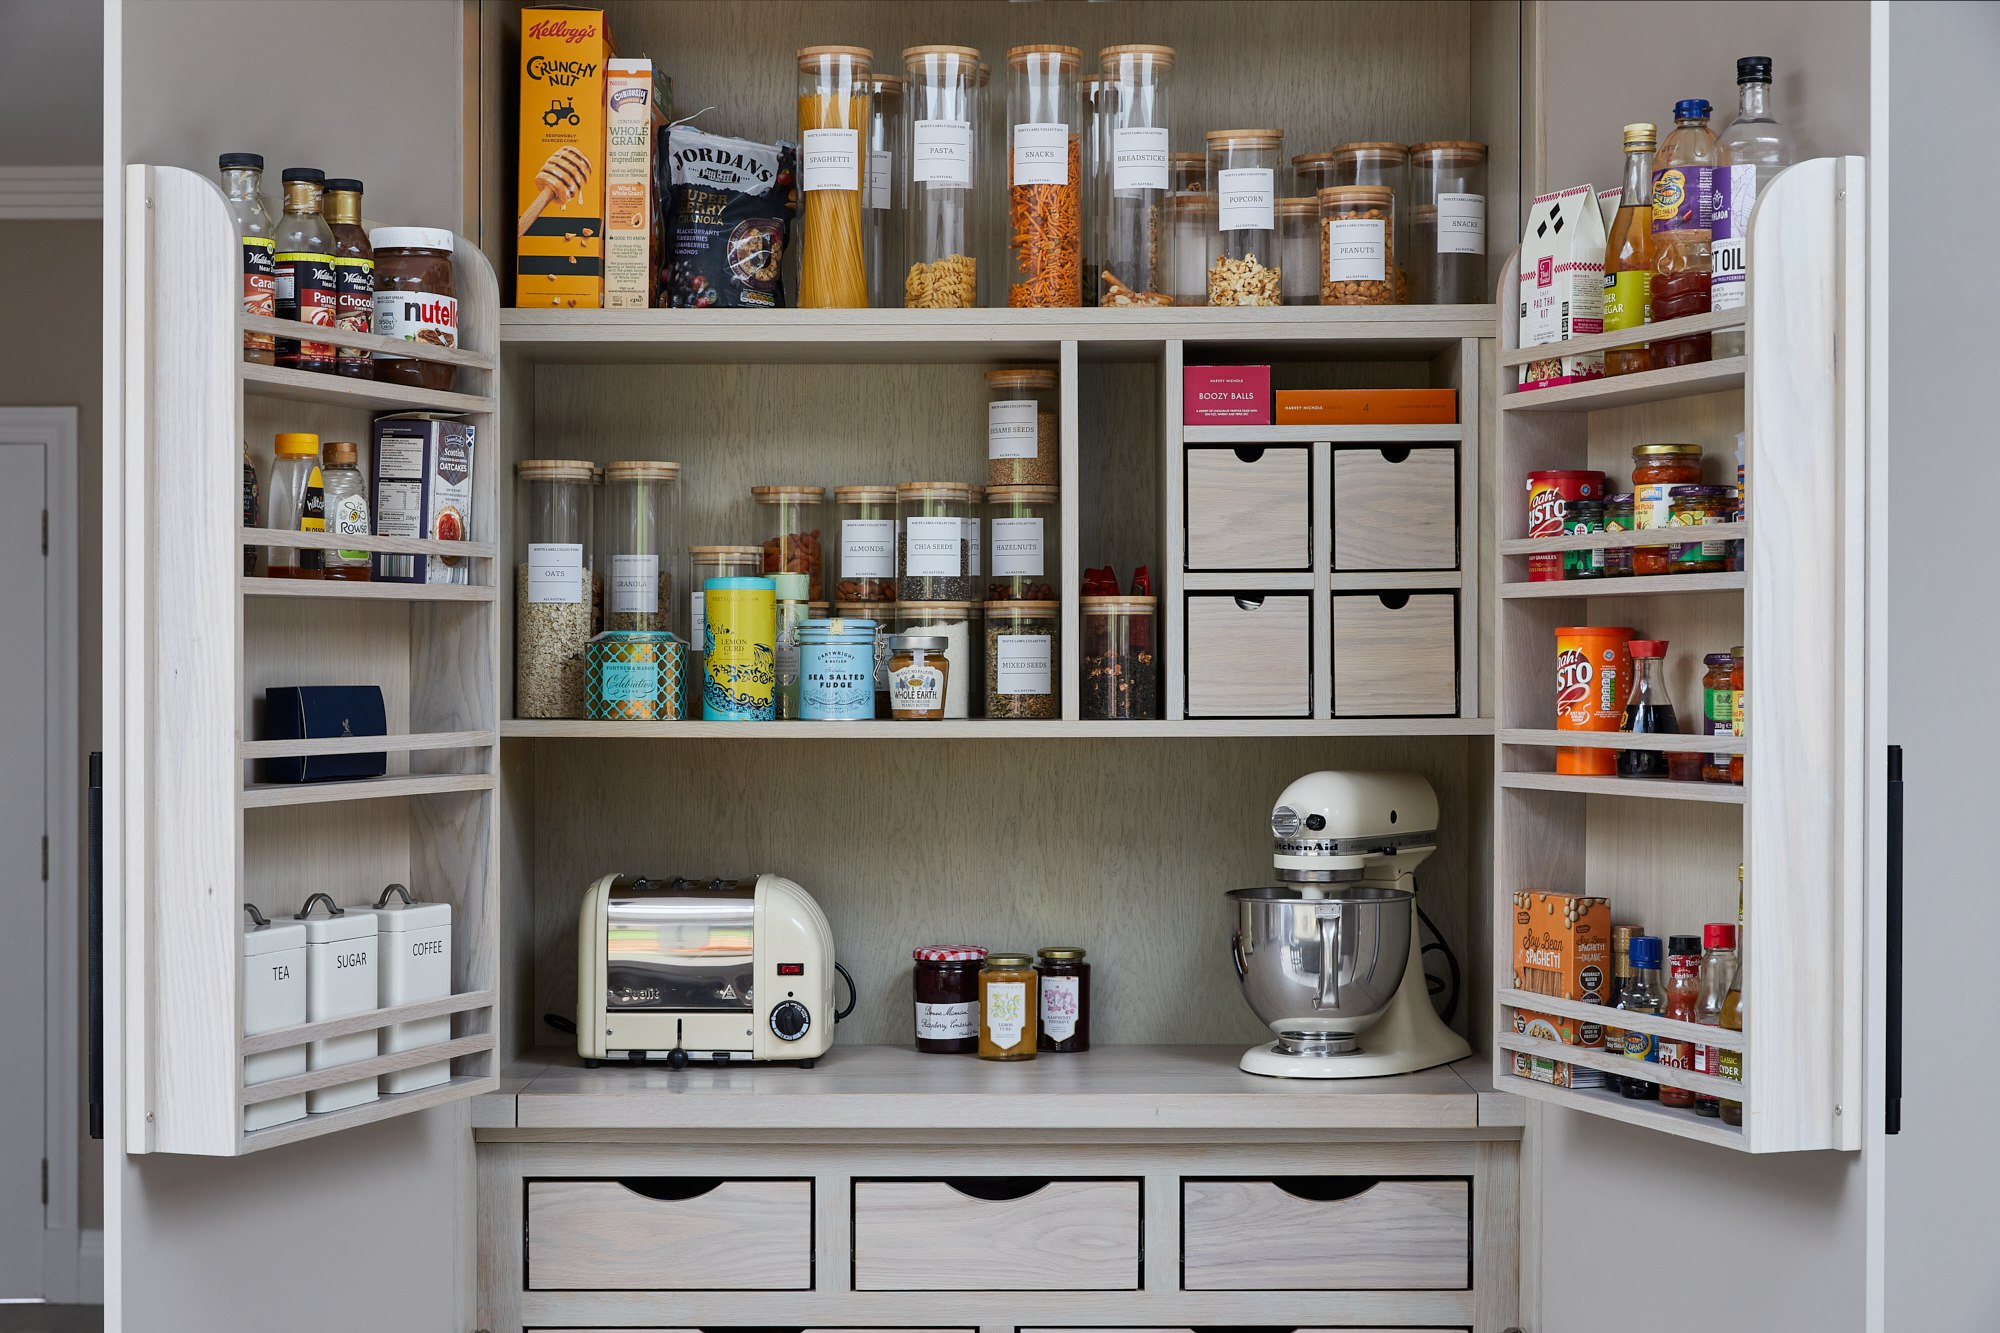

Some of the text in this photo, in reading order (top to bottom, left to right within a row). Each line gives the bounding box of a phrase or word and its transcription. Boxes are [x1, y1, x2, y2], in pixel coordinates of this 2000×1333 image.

[529, 20, 596, 43] Kellogg's
[527, 56, 597, 80] CRUNCHY
[549, 74, 579, 86] NUT
[610, 127, 648, 135] WHOLE
[612, 137, 645, 145] GRAIN
[673, 148, 773, 182] JORDANS
[1722, 248, 1745, 271] OIL
[1534, 296, 1555, 309] PAD THAI
[1604, 294, 1616, 303] DER
[1540, 309, 1548, 318] KIT
[1604, 304, 1624, 314] EGAR
[440, 463, 467, 472] OATCAKES
[341, 522, 367, 534] Rowse
[818, 651, 855, 660] CARTWRIGHT
[894, 691, 937, 699] WHOLE EARTH
[1523, 928, 1563, 952] Soy Bean
[413, 941, 442, 956] COFFEE
[337, 953, 367, 968] SUGAR
[1526, 949, 1560, 968] SPAGHETTI
[273, 966, 289, 981] TEA
[1659, 1055, 1688, 1070] Hot
